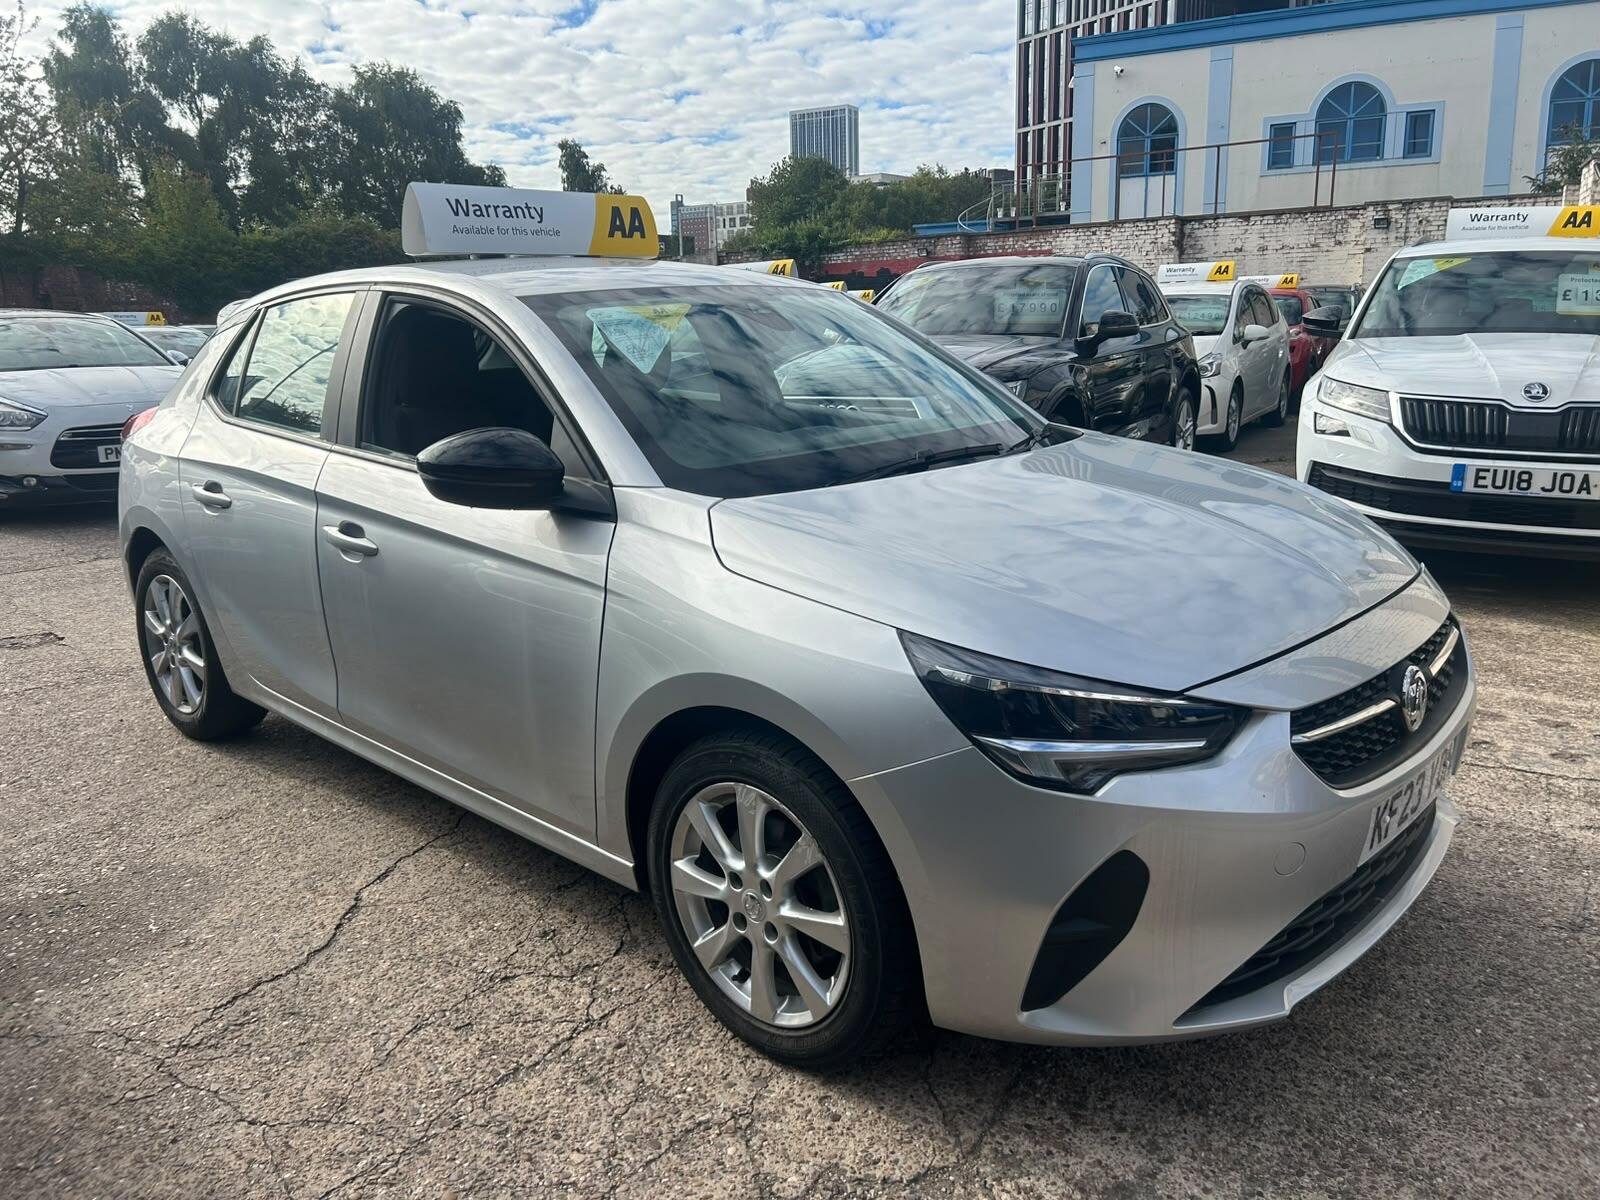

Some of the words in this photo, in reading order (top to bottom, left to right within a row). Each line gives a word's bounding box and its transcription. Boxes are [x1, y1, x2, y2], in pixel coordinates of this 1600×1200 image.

[446, 198, 544, 224] Warranty
[1469, 212, 1529, 223] Warranty
[608, 206, 646, 239] AA
[1561, 210, 1592, 228] AA
[452, 224, 495, 236] Available
[496, 225, 510, 236] for
[511, 226, 529, 237] this
[530, 227, 561, 237] vehicle
[1214, 265, 1230, 276] AA
[1281, 276, 1294, 285] AA
[150, 313, 161, 322] AA
[1473, 467, 1533, 491] EU18
[1540, 472, 1592, 495] JOA
[1369, 770, 1426, 850] KF23
